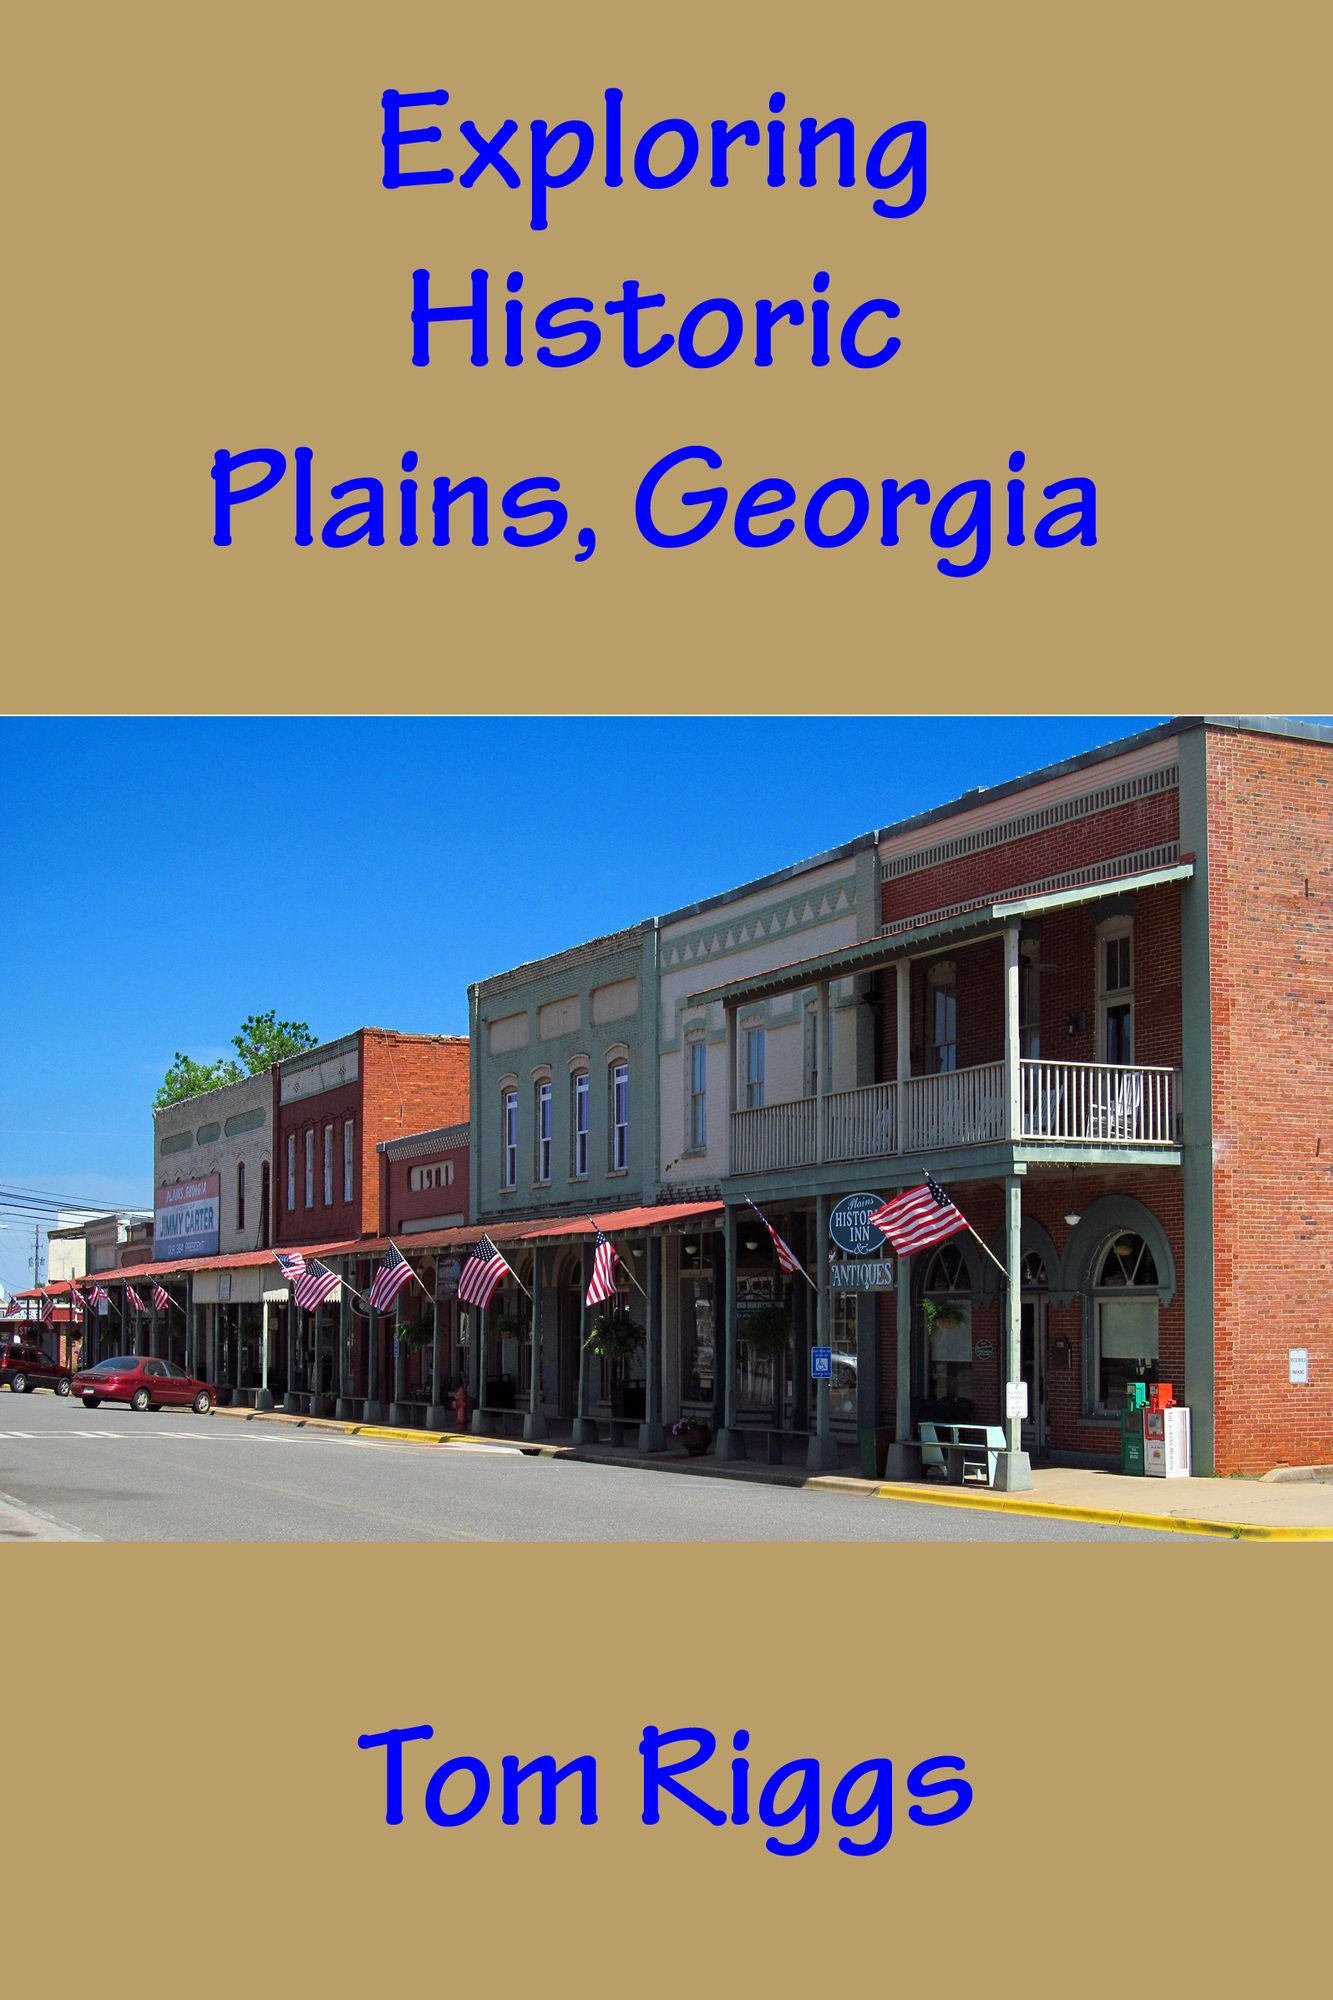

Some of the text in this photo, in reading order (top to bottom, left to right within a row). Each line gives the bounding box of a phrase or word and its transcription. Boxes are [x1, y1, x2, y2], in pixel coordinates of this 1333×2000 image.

[420, 1165, 449, 1190] 1901
[186, 1181, 207, 1199] GEORGIA
[847, 1197, 875, 1210] Plains
[160, 1206, 214, 1237] JIMMY CARTER
[835, 1210, 878, 1227] HISTOR
[850, 1226, 870, 1242] INN
[832, 1262, 892, 1290] ANTIQUES
